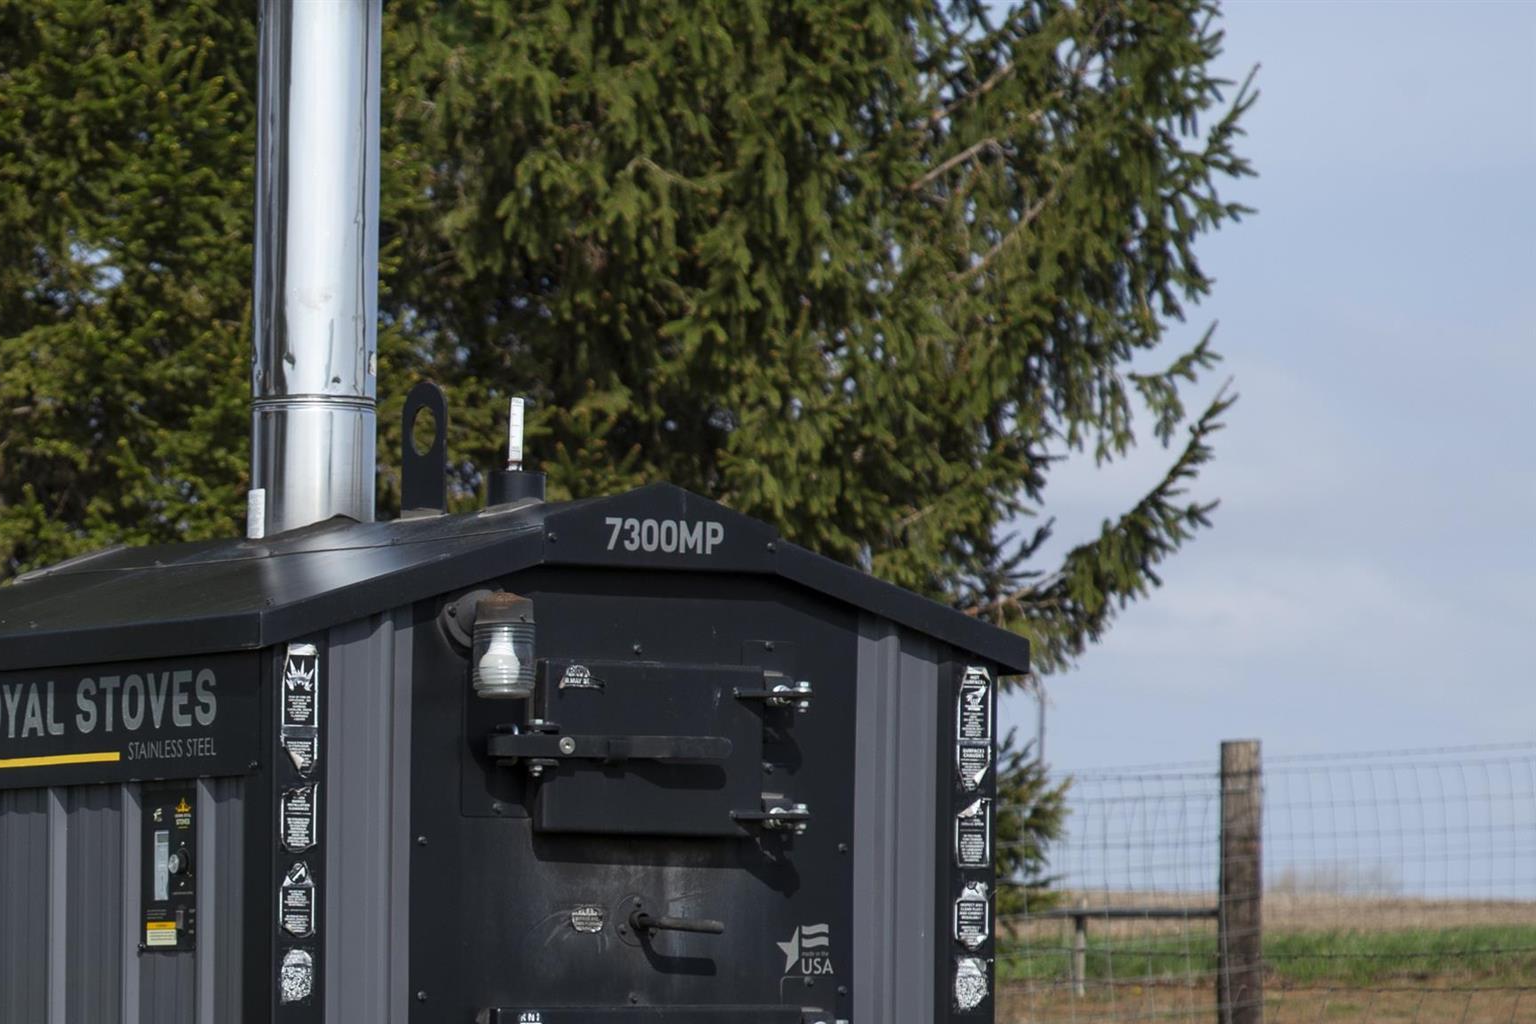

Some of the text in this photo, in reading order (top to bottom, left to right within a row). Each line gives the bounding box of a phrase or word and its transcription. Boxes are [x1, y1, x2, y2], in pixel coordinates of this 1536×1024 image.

[605, 516, 725, 555] 7300MP
[75, 668, 217, 734] STOVES
[127, 737, 217, 760] STAINLESS STEEL
[801, 958, 834, 975] USA
